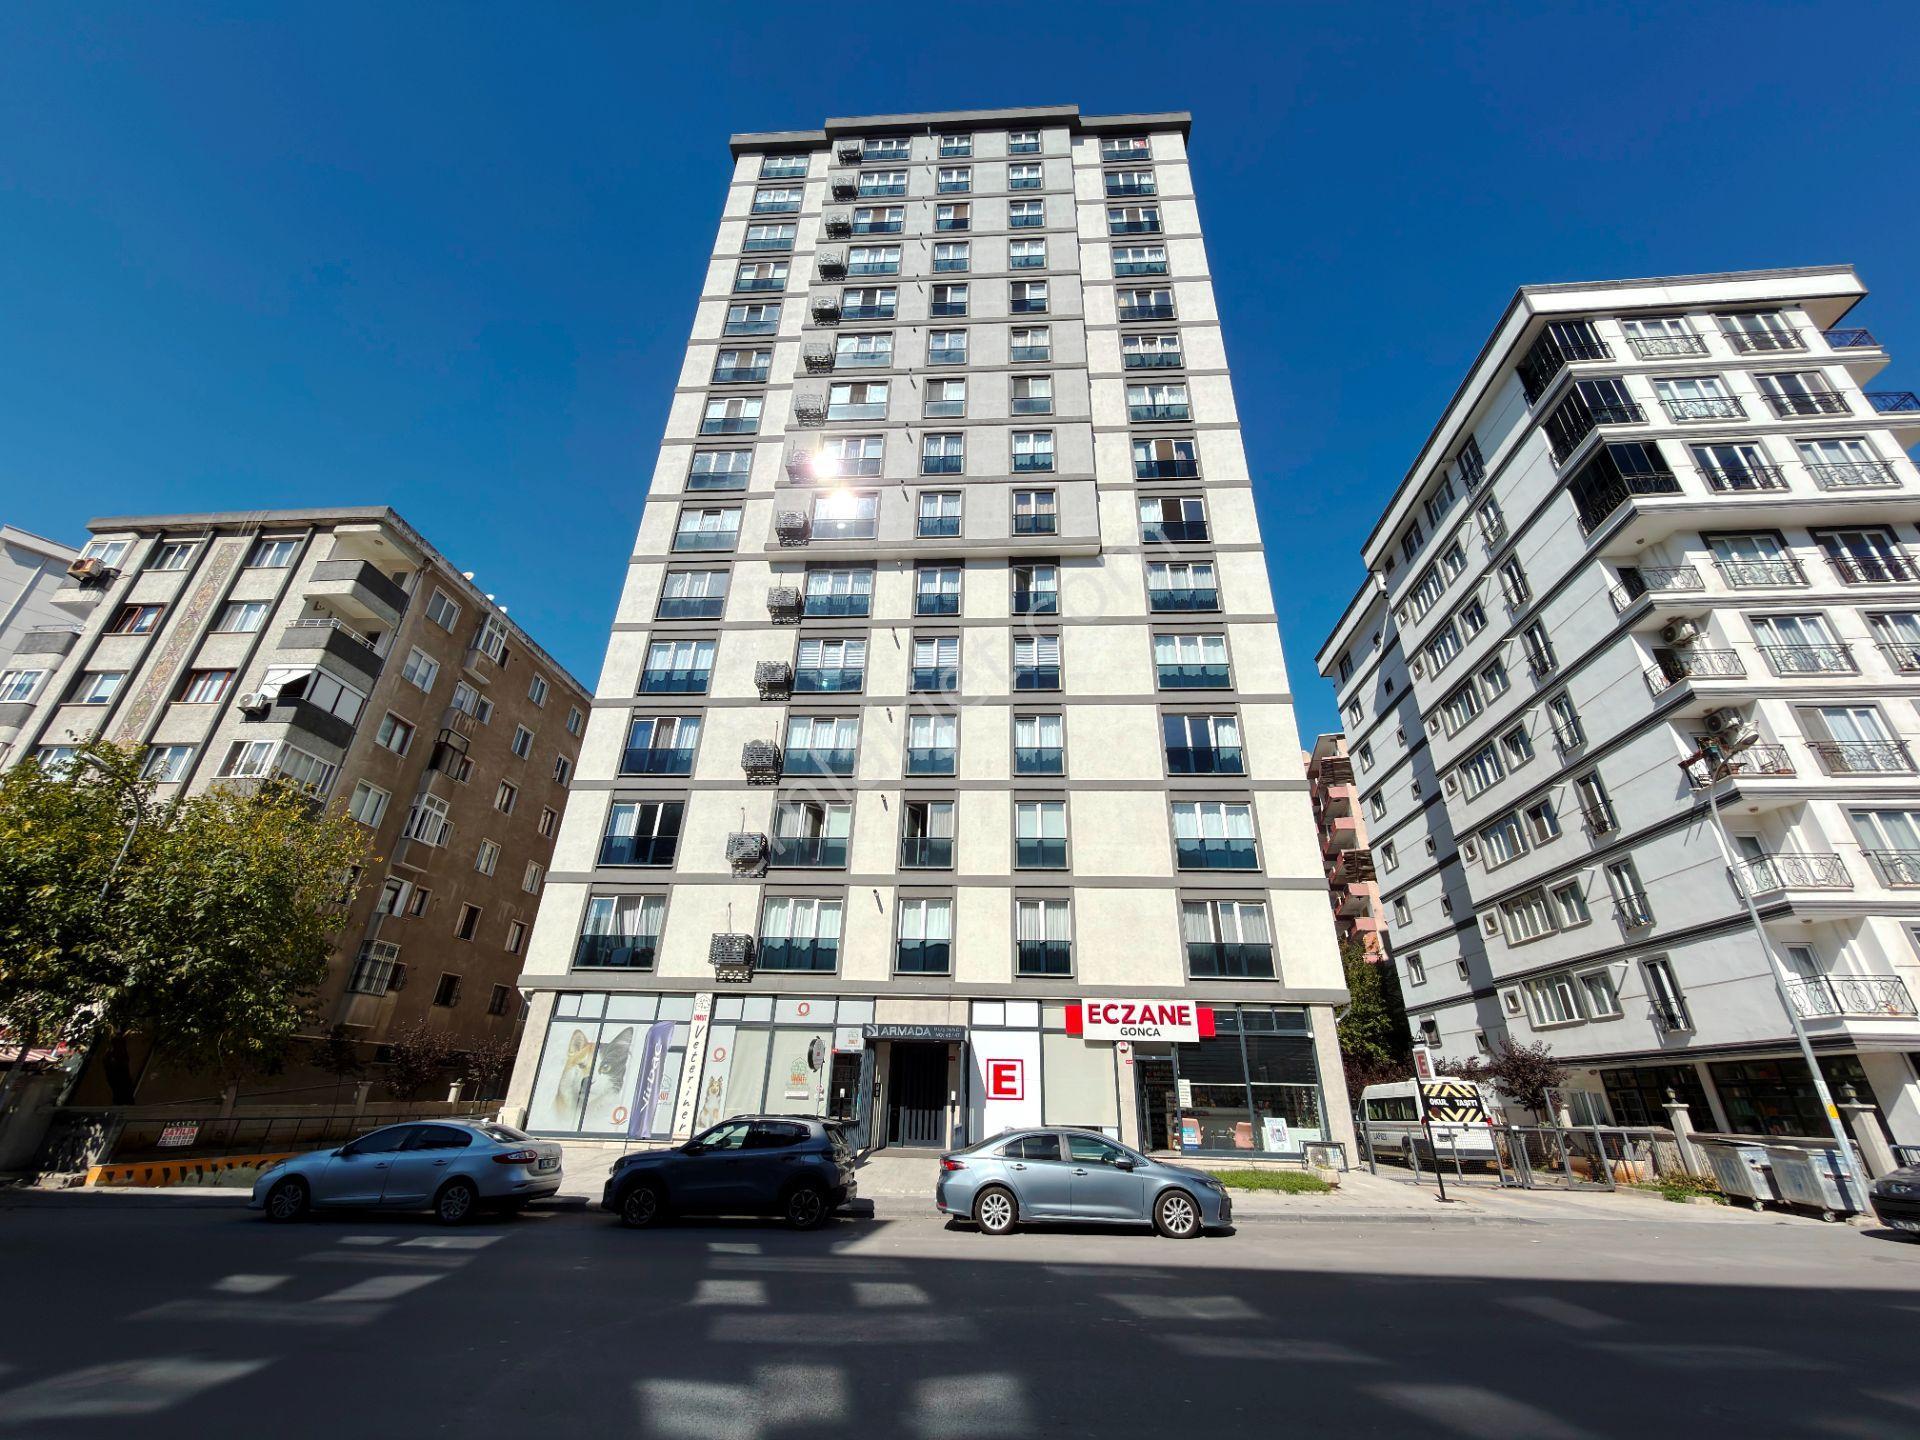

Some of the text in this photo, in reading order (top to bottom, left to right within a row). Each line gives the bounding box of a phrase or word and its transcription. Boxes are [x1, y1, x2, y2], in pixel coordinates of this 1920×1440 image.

[1087, 1003, 1192, 1026] ECZANE
[880, 1025, 932, 1037] ARMADA
[1119, 1026, 1161, 1037] GONCA
[1417, 1054, 1431, 1076] E
[679, 1024, 706, 1132] Veteriner
[992, 1063, 1017, 1095] E
[1429, 1098, 1450, 1107] OKUL
